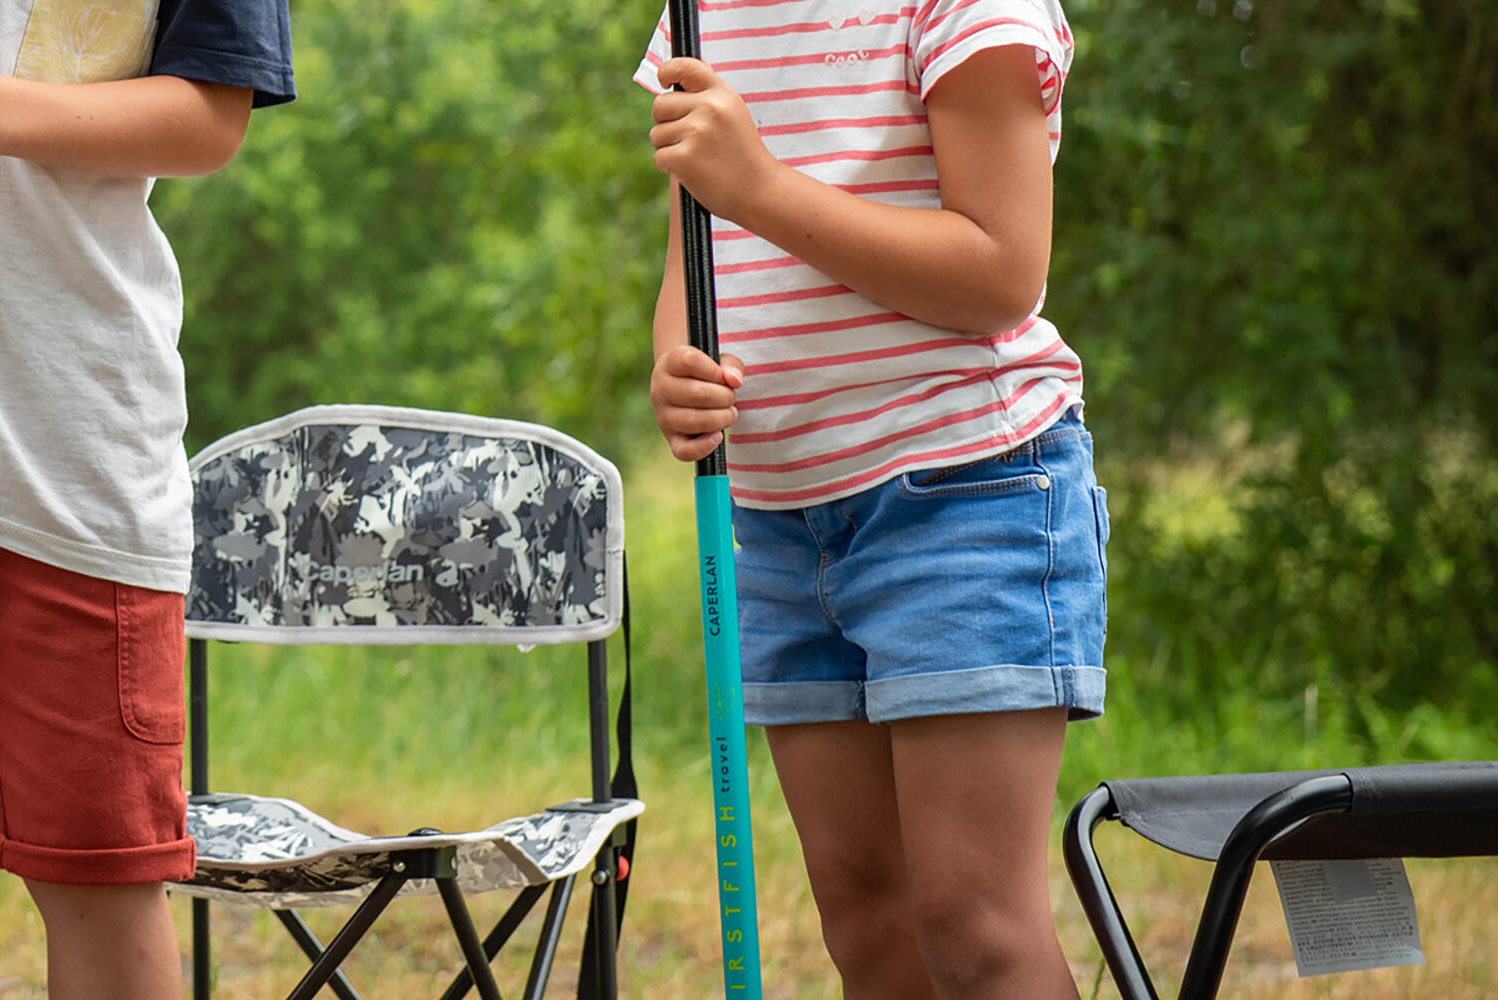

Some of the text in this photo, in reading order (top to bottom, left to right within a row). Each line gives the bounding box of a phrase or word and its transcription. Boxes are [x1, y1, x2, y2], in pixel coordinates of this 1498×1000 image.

[705, 555, 720, 636] CAPERLAN
[716, 736, 746, 991] IRSTFISH travel
